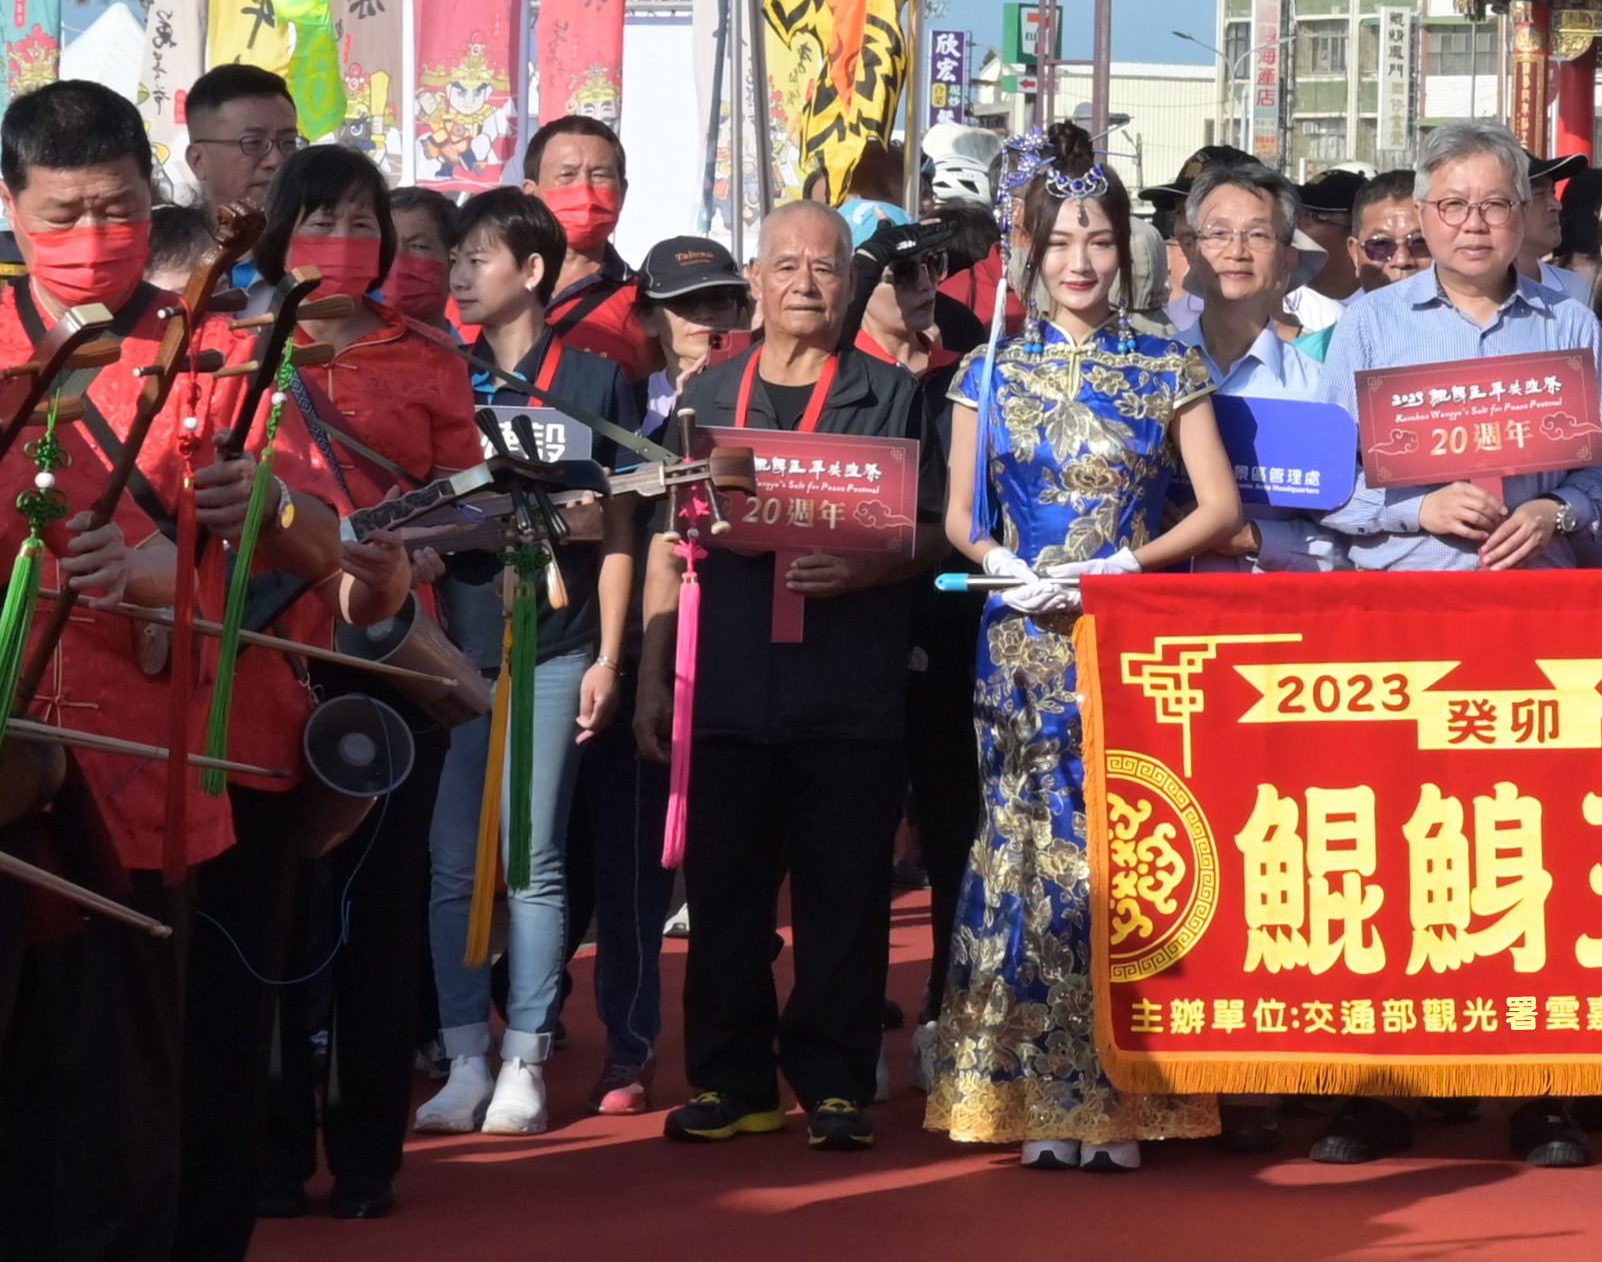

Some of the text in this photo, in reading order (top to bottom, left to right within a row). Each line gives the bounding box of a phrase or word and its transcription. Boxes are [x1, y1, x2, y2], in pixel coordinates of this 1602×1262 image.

[1471, 405, 1488, 416] Salt
[1490, 404, 1502, 417] for
[1503, 401, 1528, 412] Peace
[1529, 396, 1562, 409] Festival
[1430, 418, 1534, 456] 20週年
[788, 480, 805, 490] Salt
[806, 481, 819, 493] for
[820, 482, 845, 493] Peace
[846, 483, 880, 494] Festival
[742, 497, 846, 530] 20週年
[1276, 673, 1412, 715] 2023
[1446, 700, 1562, 746] 癸卯
